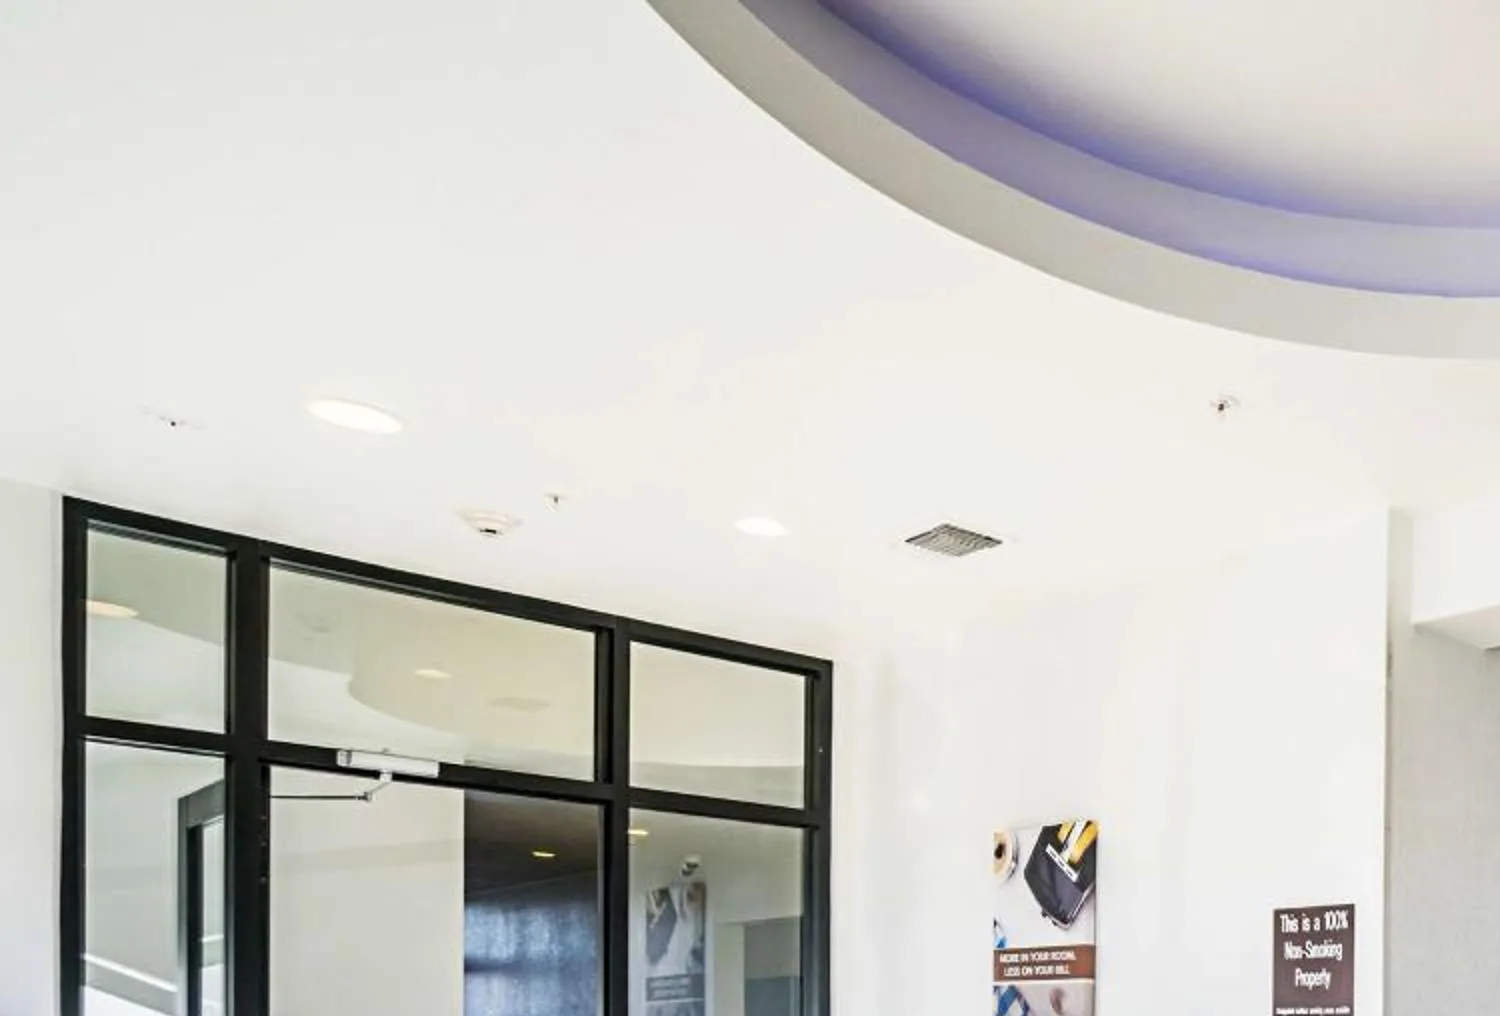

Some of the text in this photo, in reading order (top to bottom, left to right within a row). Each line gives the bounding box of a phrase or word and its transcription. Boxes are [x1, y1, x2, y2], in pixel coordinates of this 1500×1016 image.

[1280, 909, 1349, 933] This is a 100%
[1284, 939, 1343, 961] Non-Smoking
[1034, 965, 1054, 976] YOUR
[1294, 967, 1332, 991] Property
